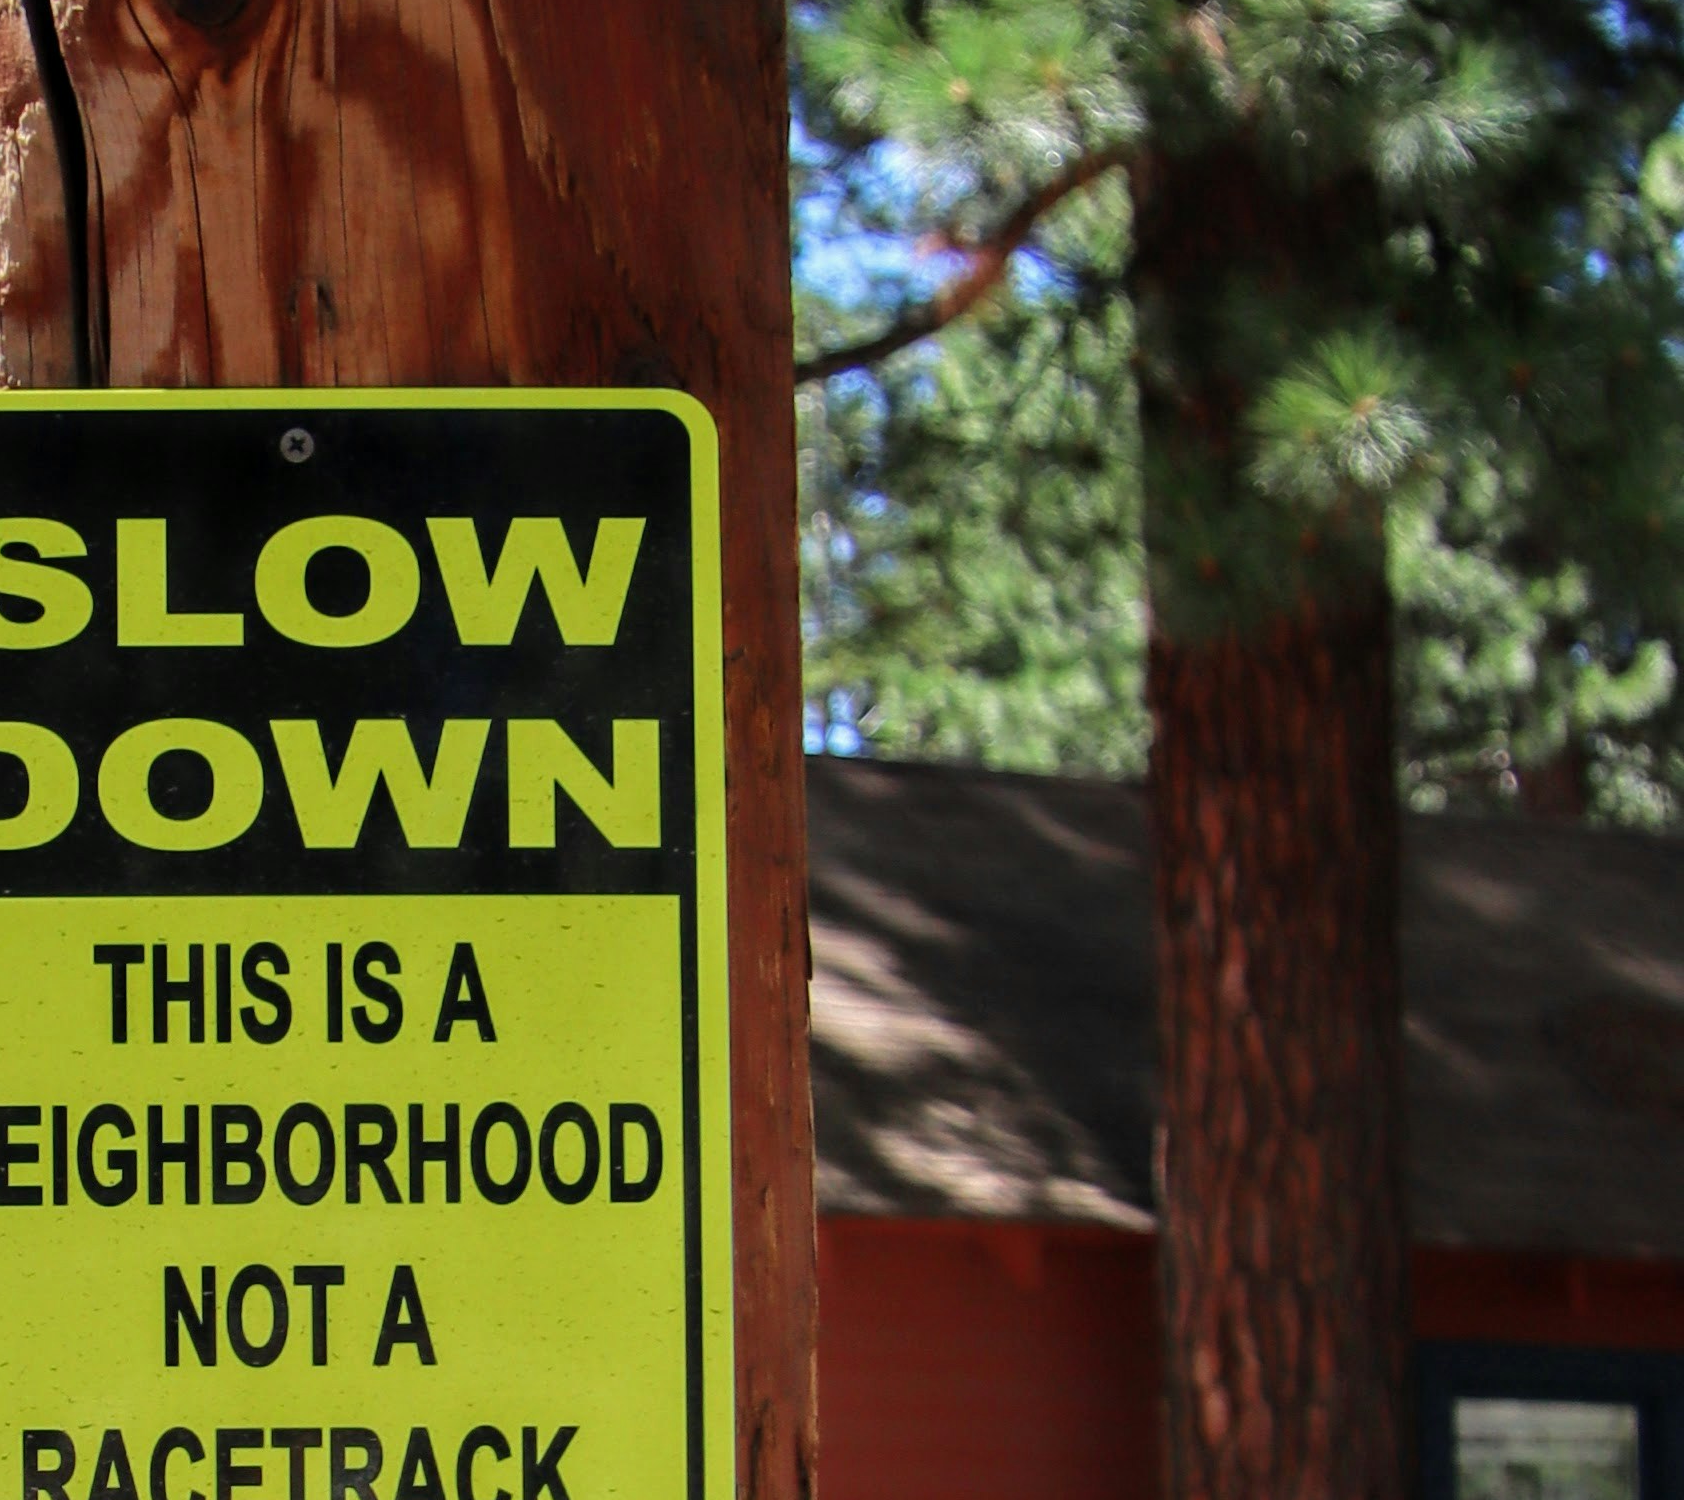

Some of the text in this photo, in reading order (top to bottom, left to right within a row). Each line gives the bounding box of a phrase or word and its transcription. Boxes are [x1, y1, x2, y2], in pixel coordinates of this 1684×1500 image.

[94, 941, 497, 1044] THIS IS A
[165, 1264, 436, 1367] NOT A
